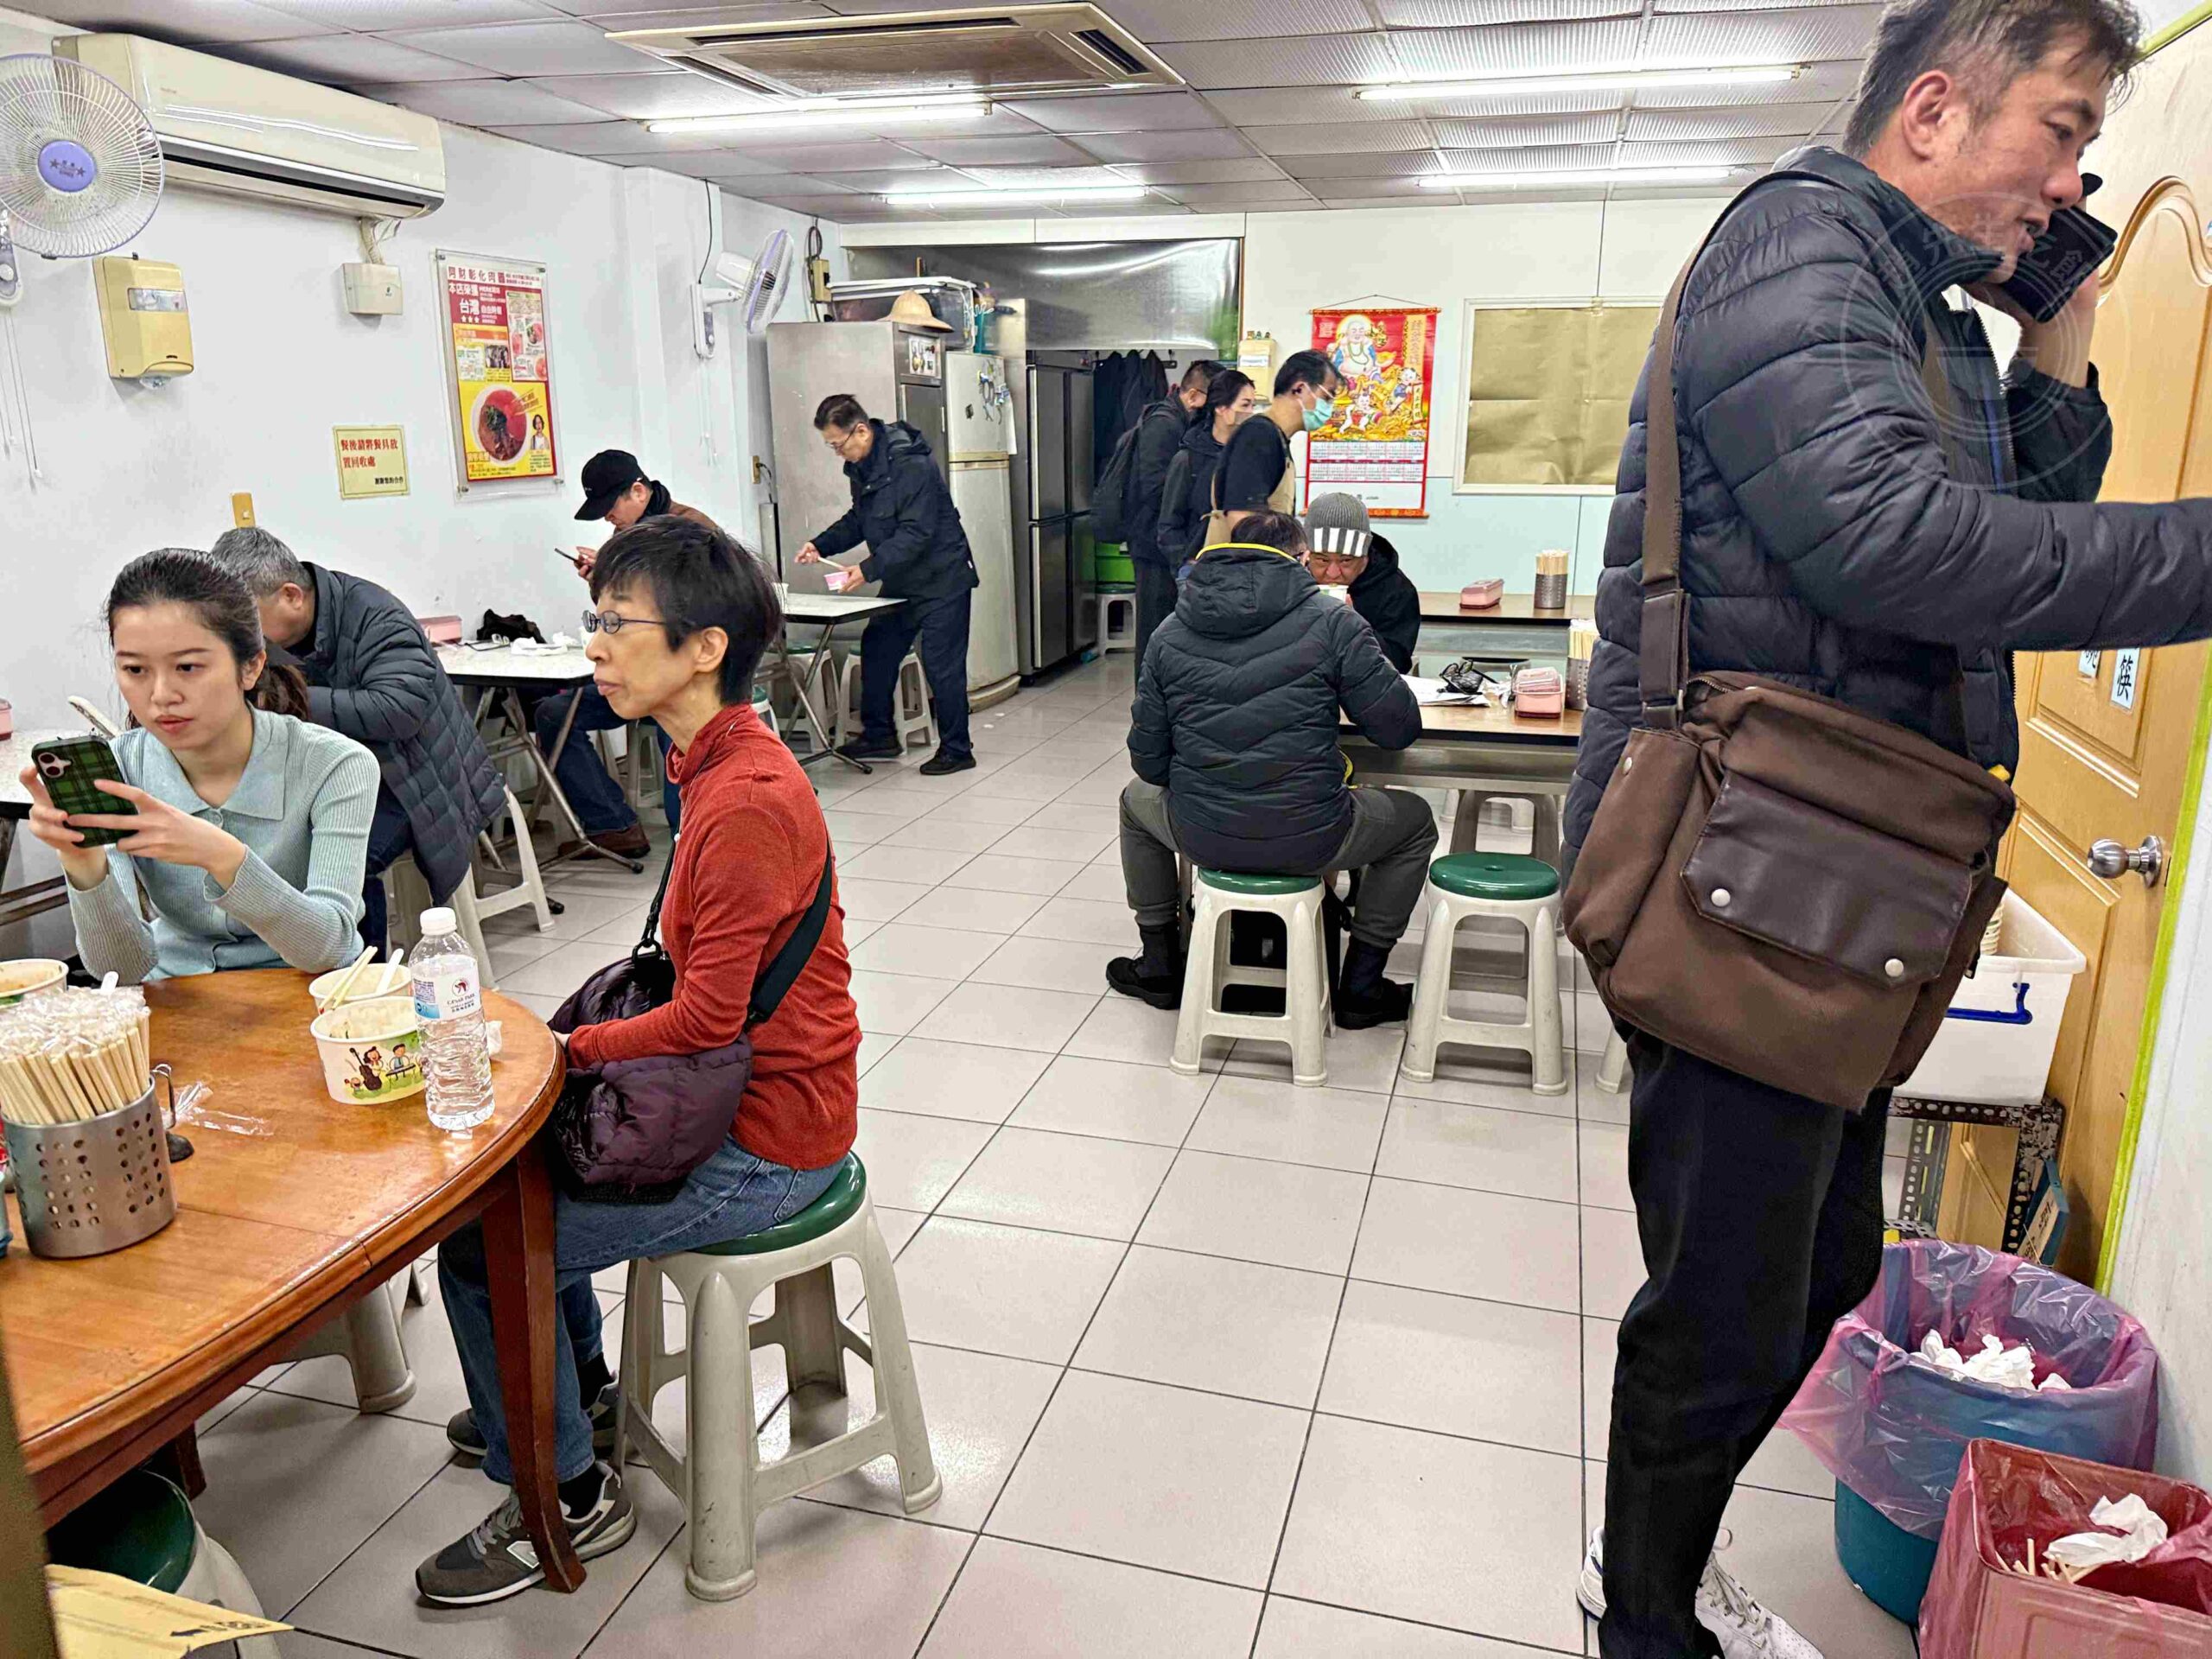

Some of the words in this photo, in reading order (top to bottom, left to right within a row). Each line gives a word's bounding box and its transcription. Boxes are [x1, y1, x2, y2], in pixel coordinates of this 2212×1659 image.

[460, 298, 480, 315] 台灣
[340, 438, 398, 450] 餐後請將餐具放
[343, 456, 376, 468] 置回收處
[2117, 655, 2133, 701] 筷
